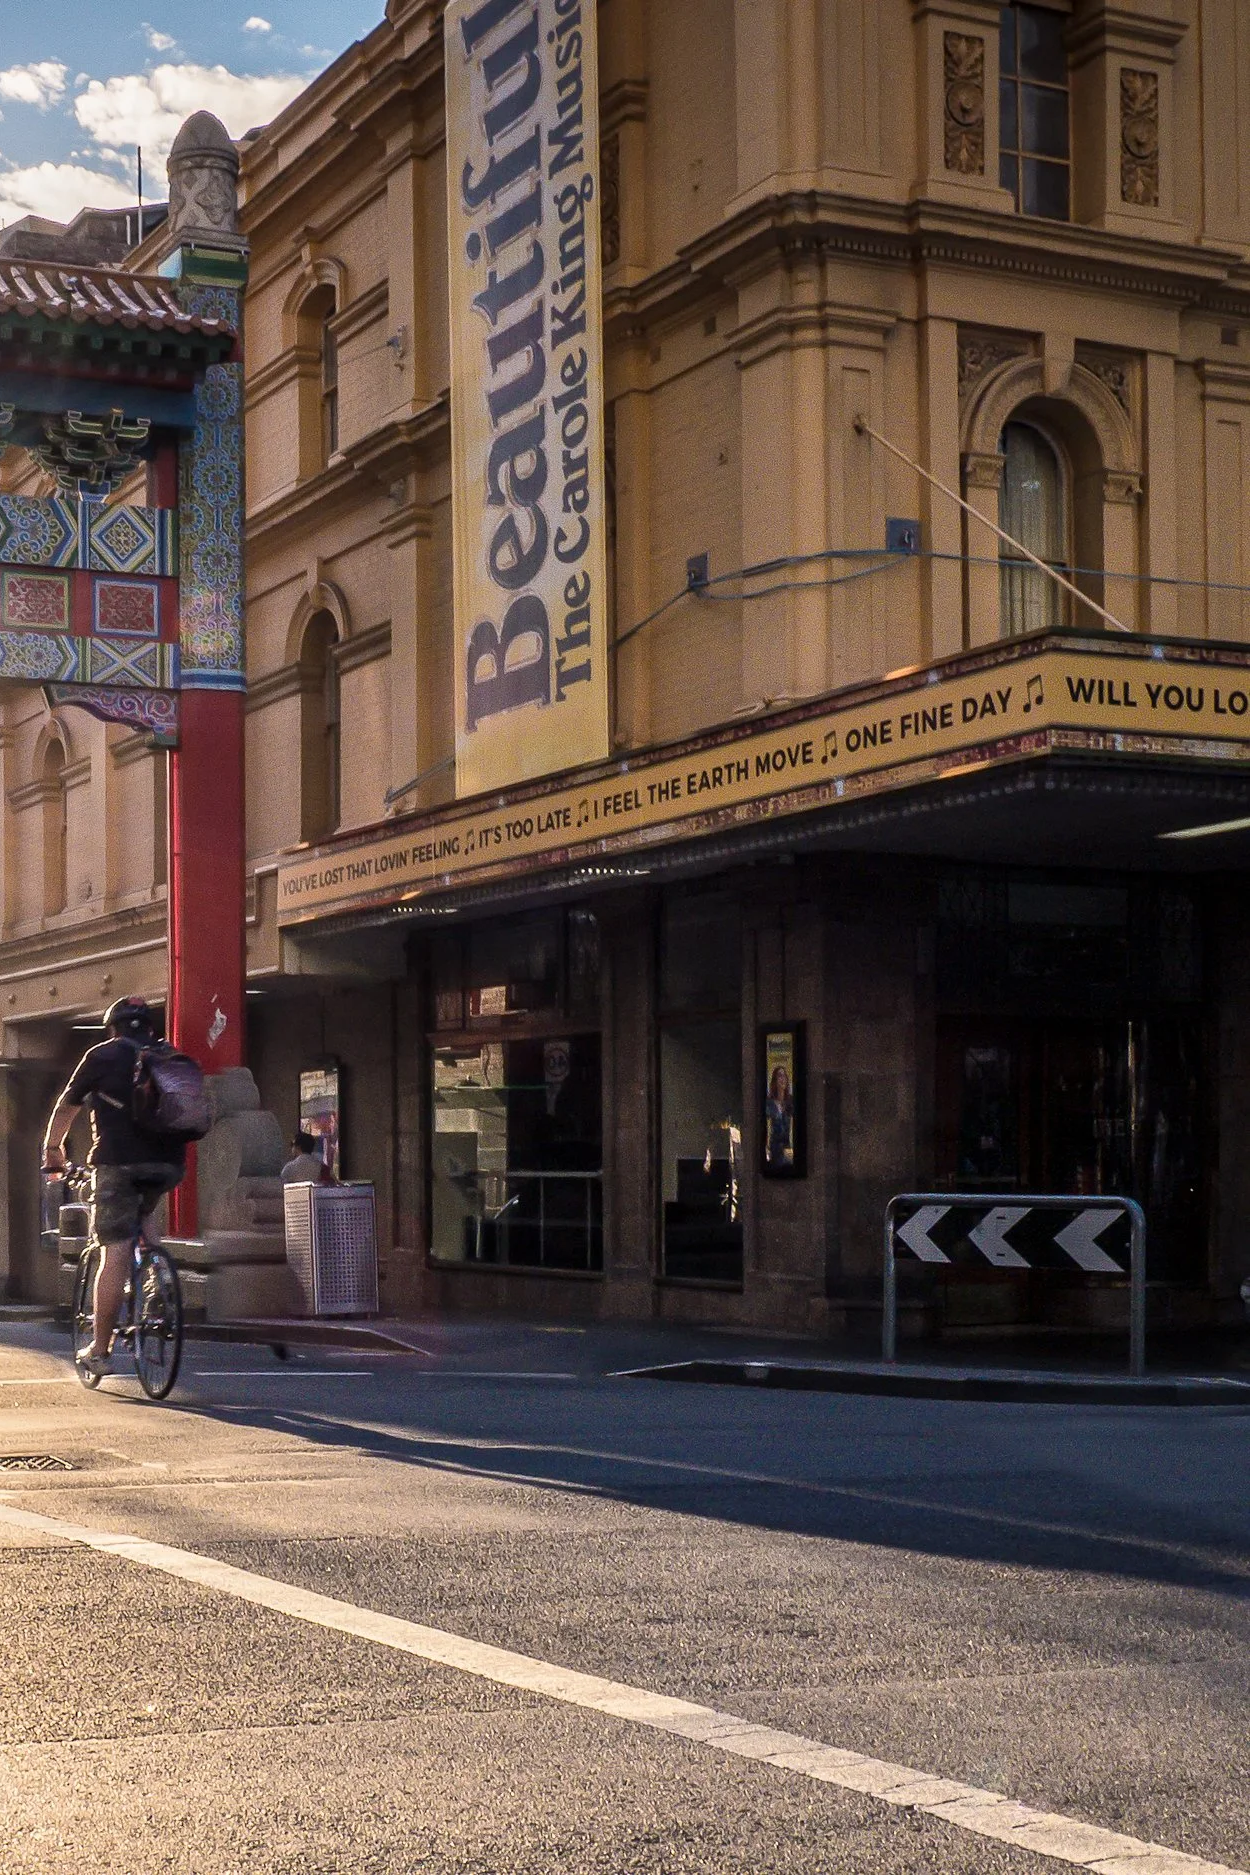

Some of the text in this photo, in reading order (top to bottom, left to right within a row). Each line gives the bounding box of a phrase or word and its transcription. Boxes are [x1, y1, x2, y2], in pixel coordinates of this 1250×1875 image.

[550, 172, 594, 352] King
[461, 0, 551, 734] Beautiful
[551, 346, 592, 565] Carole
[555, 569, 592, 702] The
[1066, 675, 1249, 716] WILL YOU LO
[282, 686, 1012, 897] YOU'VE LOST THAT LOVIN' FEELING IT'S TOO LATE I FEEL THE EARTH MOVE ONE FINE DAY
